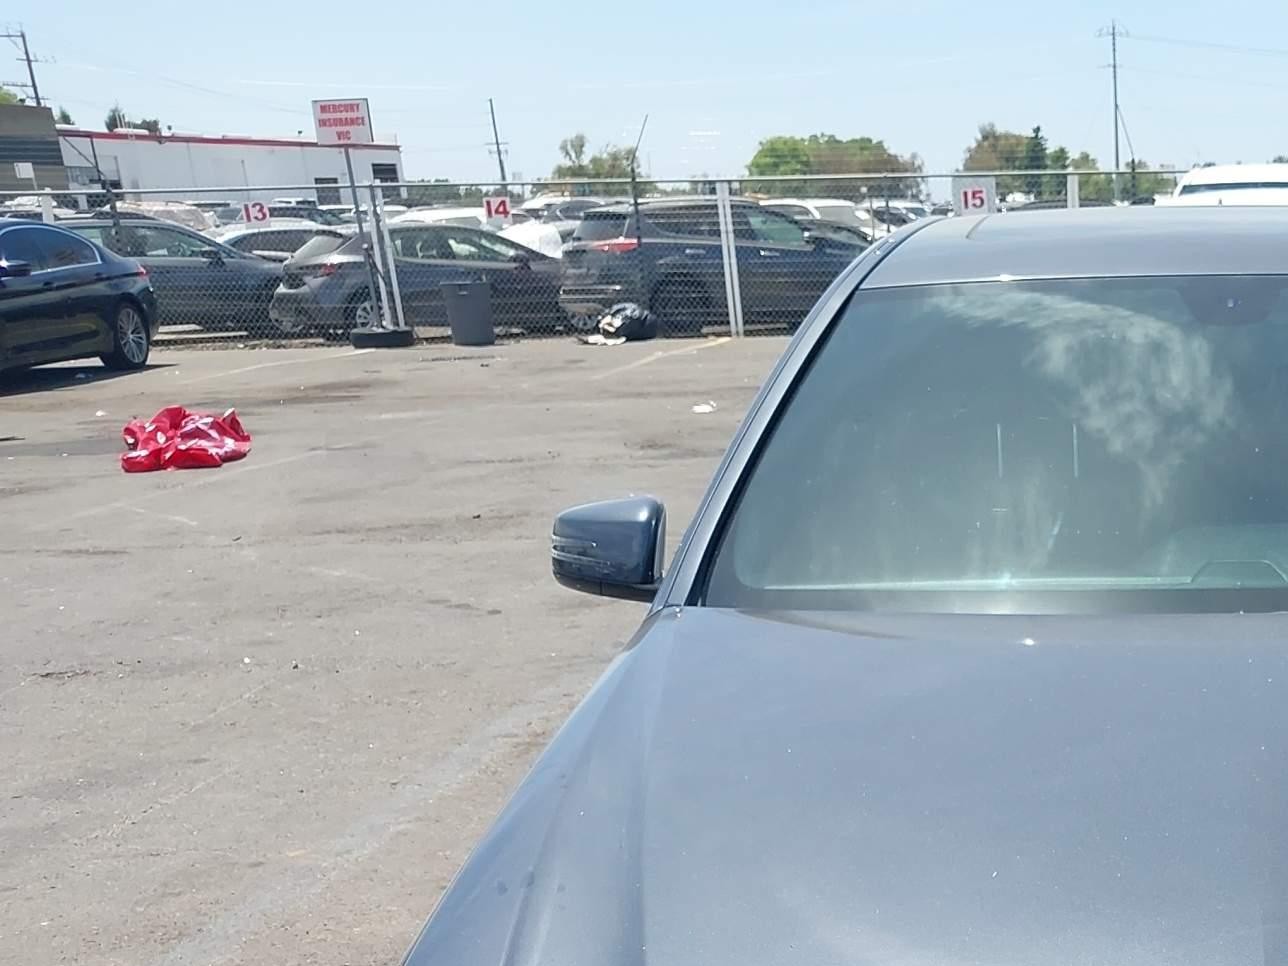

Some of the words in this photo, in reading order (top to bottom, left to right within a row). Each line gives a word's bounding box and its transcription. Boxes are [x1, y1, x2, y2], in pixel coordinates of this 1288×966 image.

[319, 103, 360, 114] MERCURY
[318, 116, 366, 128] INSURANCE
[335, 130, 352, 141] VIC
[962, 189, 985, 210] 15
[243, 202, 267, 223] 13
[485, 199, 510, 219] 14
